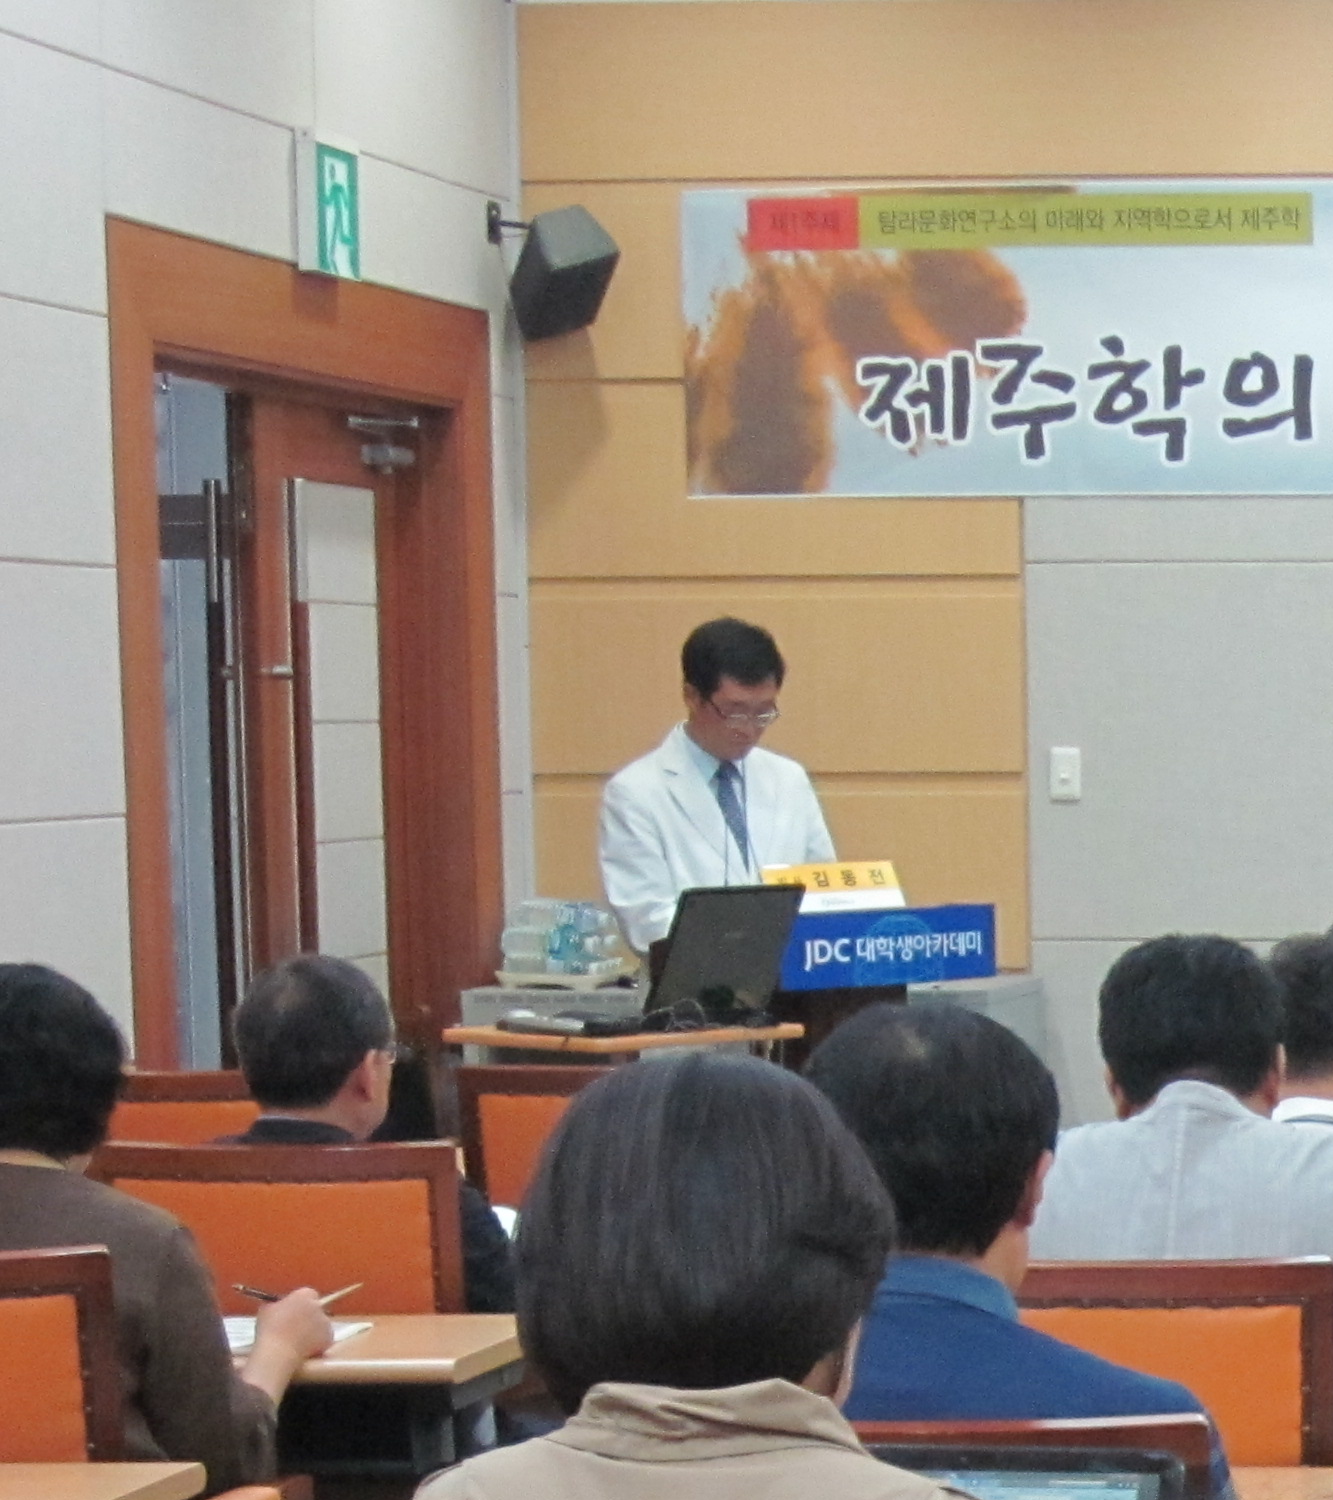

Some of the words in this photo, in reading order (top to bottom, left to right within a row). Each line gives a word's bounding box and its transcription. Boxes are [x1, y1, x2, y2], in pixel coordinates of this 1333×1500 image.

[878, 209, 1037, 234] 탐라문화연구소의
[1045, 208, 1104, 233] 미래와
[1113, 206, 1233, 232] 지역학으로서
[1240, 206, 1301, 232] 제주학
[858, 336, 1315, 462] 제주학의
[804, 938, 851, 972] JDC
[856, 930, 983, 962] 대학생아카데미
